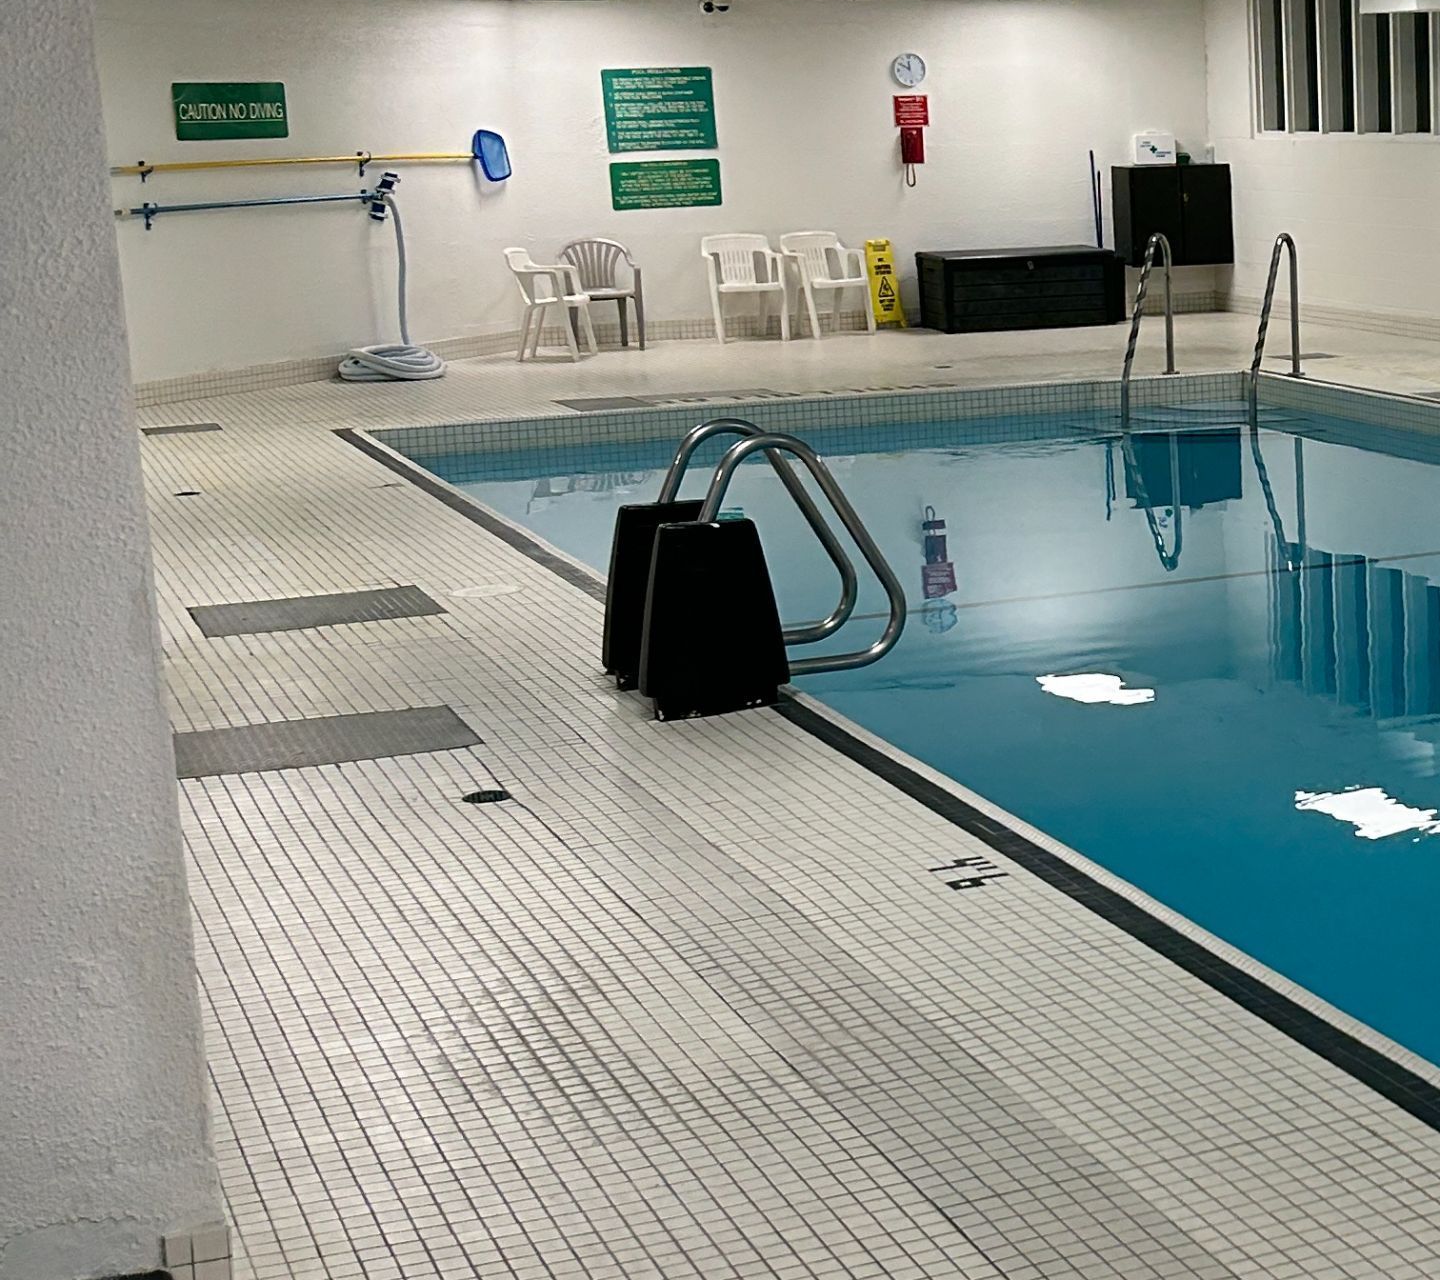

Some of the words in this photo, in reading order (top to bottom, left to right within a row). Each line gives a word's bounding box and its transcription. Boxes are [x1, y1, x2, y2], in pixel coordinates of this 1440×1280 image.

[179, 103, 227, 120] CAUTION
[229, 103, 247, 119] NO
[249, 102, 284, 119] DIVING
